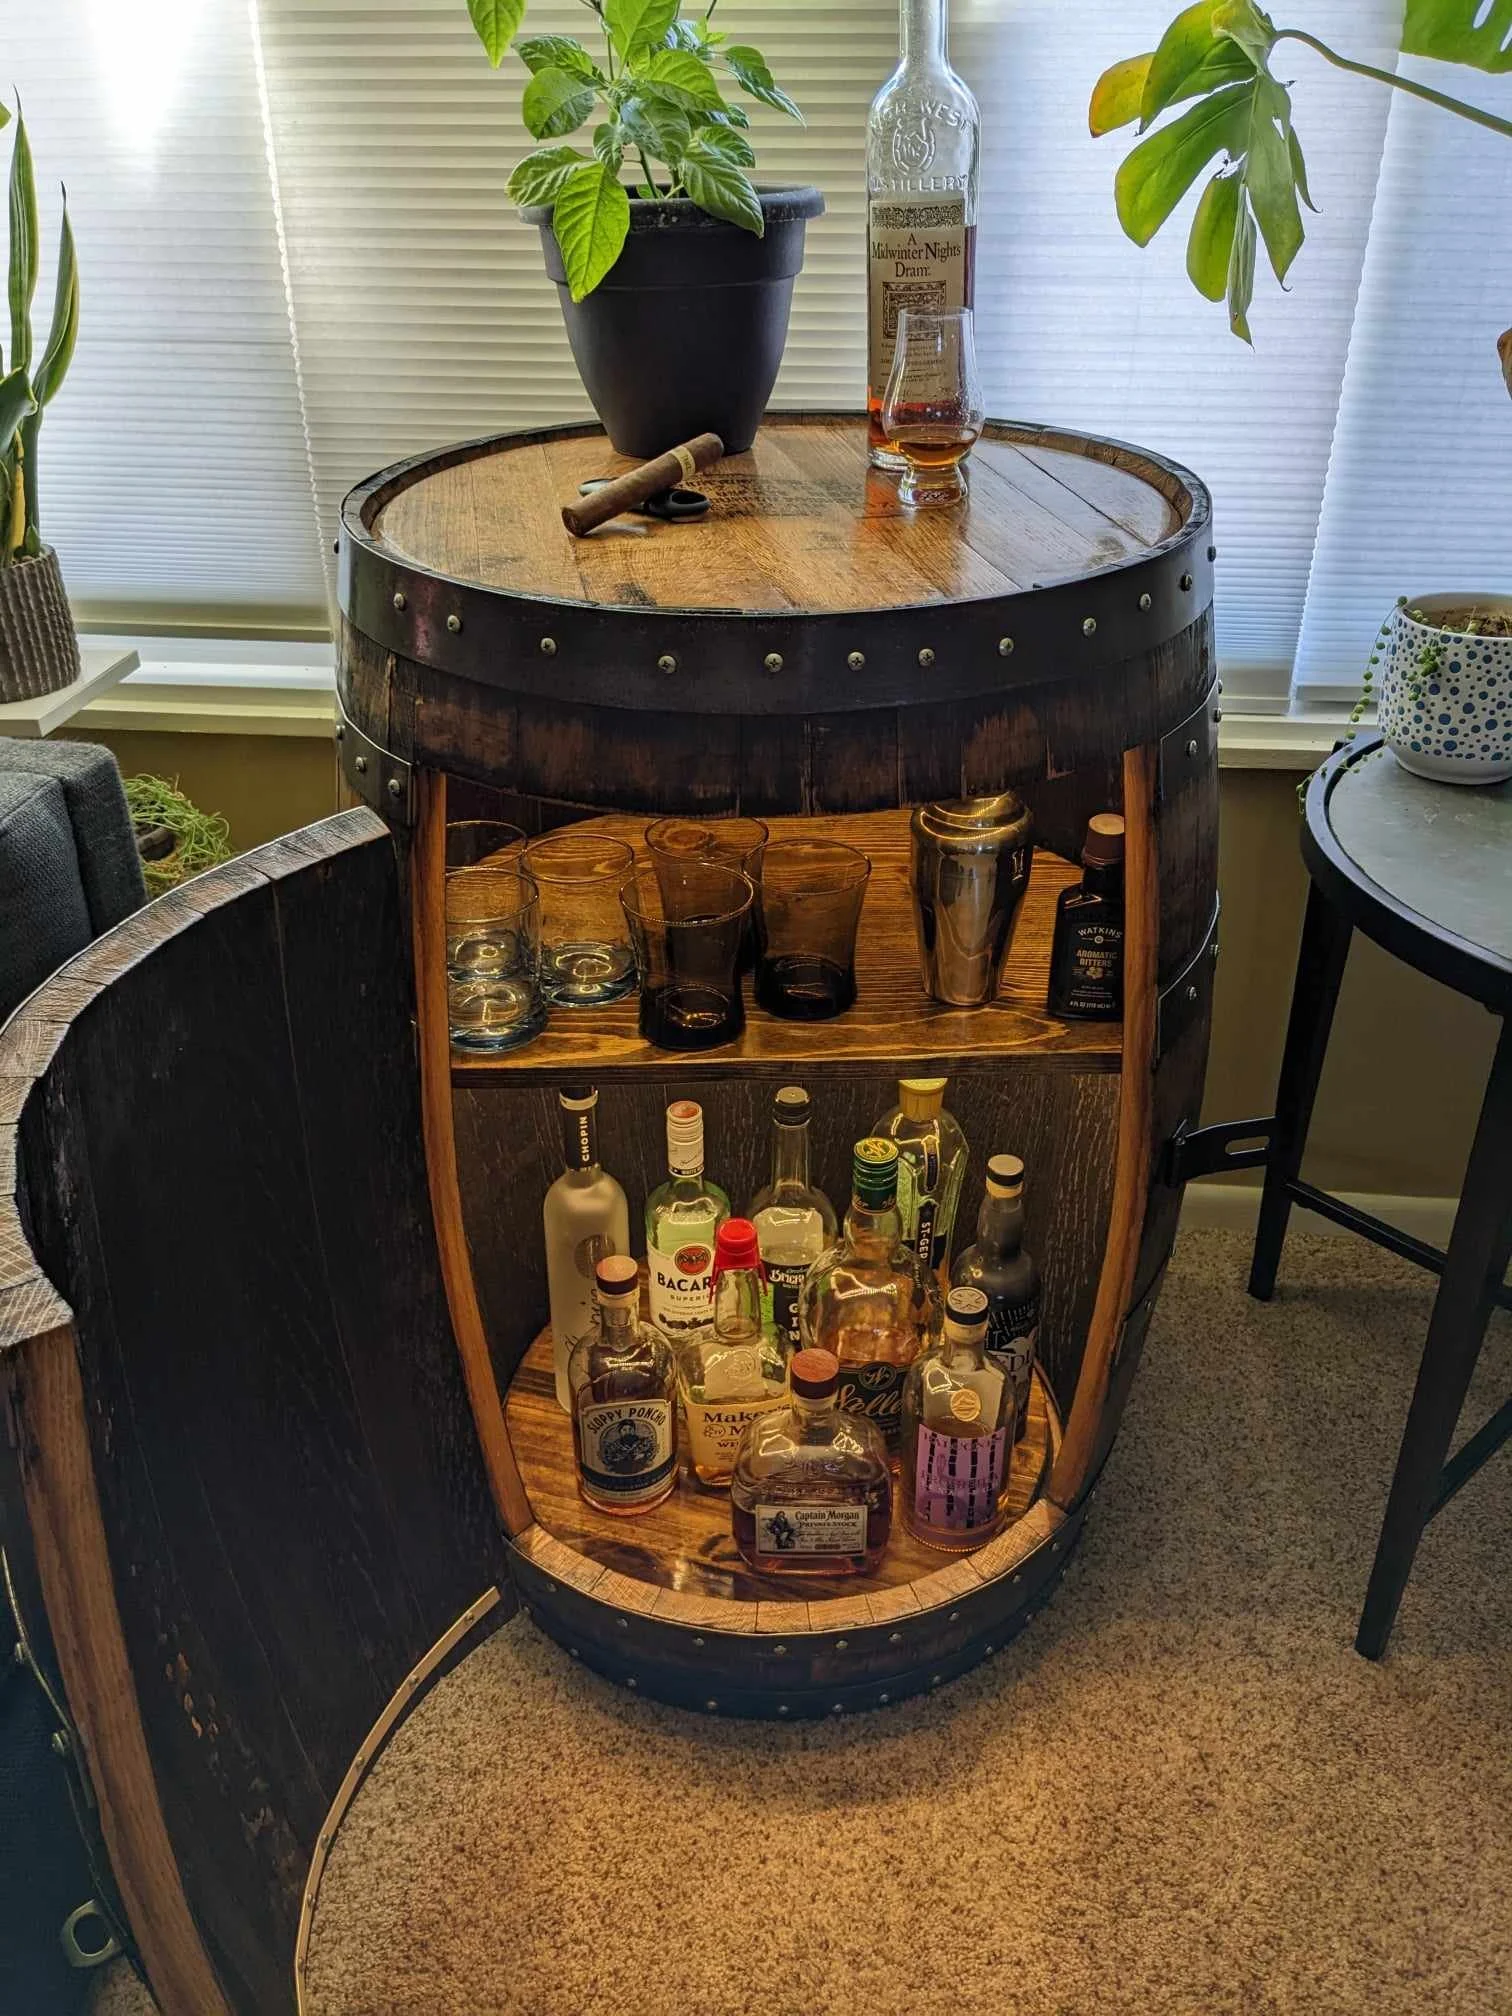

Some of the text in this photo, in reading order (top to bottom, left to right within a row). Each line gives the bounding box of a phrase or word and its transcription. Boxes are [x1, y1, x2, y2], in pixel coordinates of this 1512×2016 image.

[907, 232, 917, 246] A
[872, 241, 961, 263] Midwinter Nights
[1077, 926, 1123, 938] WATKINS
[1076, 948, 1118, 960] AROMATIC
[1079, 958, 1112, 969] BITTERS
[579, 1115, 590, 1162] CHOPIN
[657, 1271, 713, 1292] BACAR
[586, 1407, 667, 1434] SLOPPY PONCHO
[795, 1510, 860, 1522] Captain Morgan
